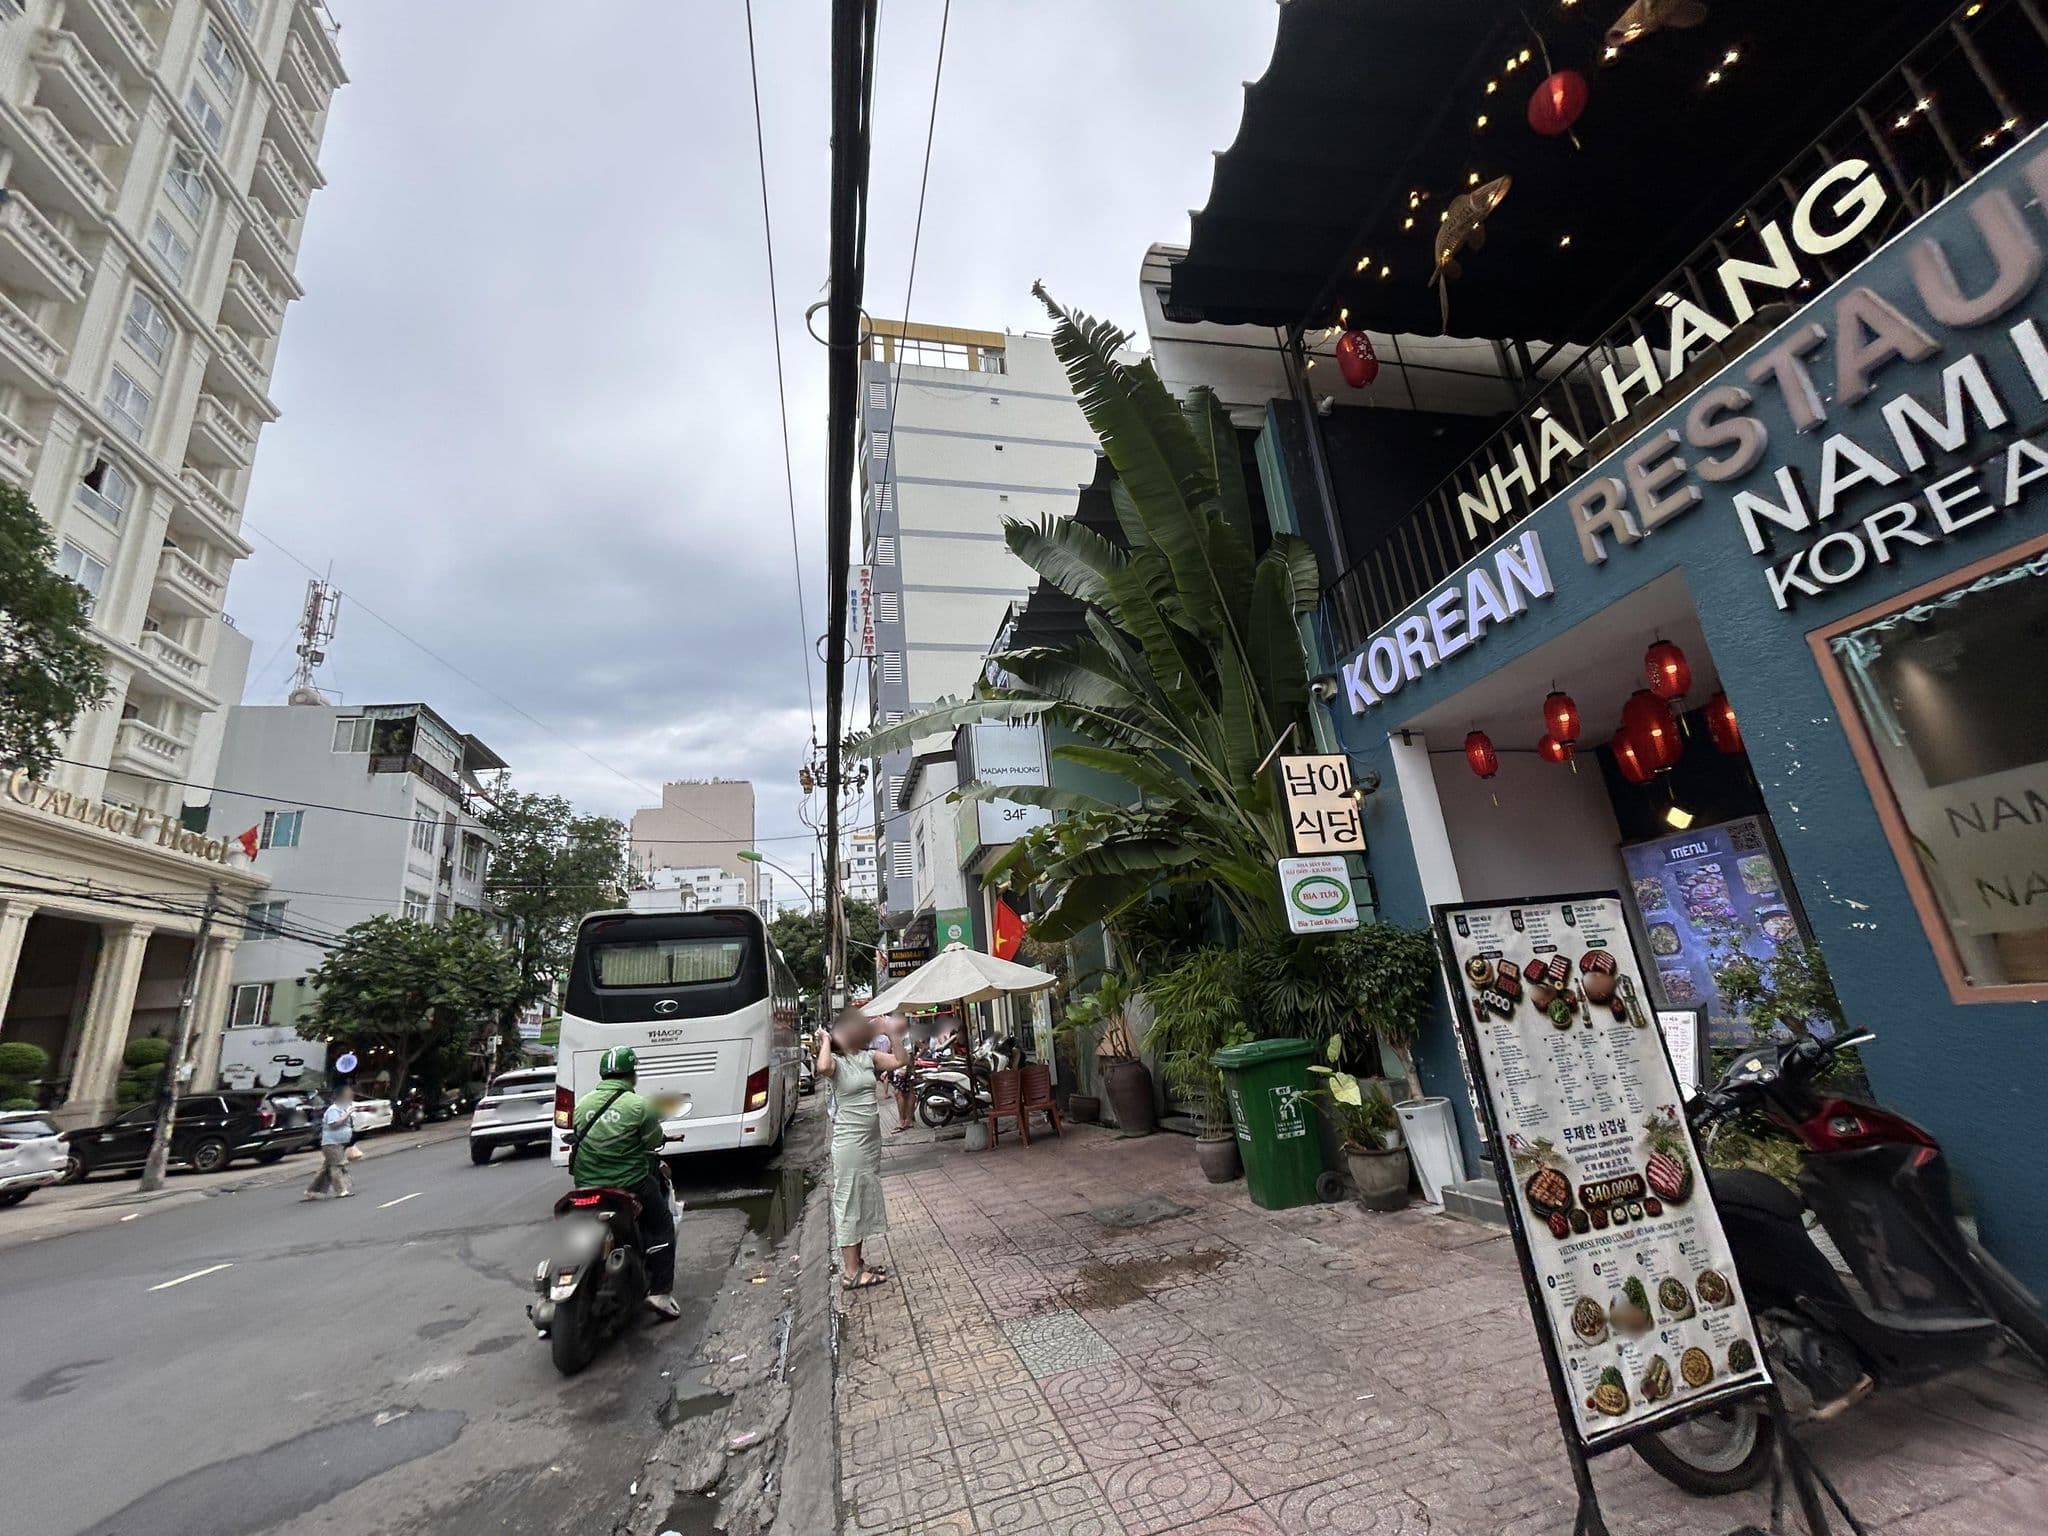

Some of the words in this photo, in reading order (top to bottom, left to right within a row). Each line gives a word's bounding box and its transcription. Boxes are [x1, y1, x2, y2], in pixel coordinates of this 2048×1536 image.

[1457, 405, 1585, 540] NHÀ
[1600, 158, 1887, 423] HÀNG
[1342, 530, 1555, 715] KOREAN
[981, 767, 1008, 775] MADAM
[1285, 762, 1349, 797] 남이
[1003, 808, 1027, 821] 34F
[1295, 808, 1358, 845] 식당
[1671, 841, 1708, 860] MENU
[1562, 1123, 1596, 1144] 무제한
[1599, 1117, 1628, 1137] 삼겹살
